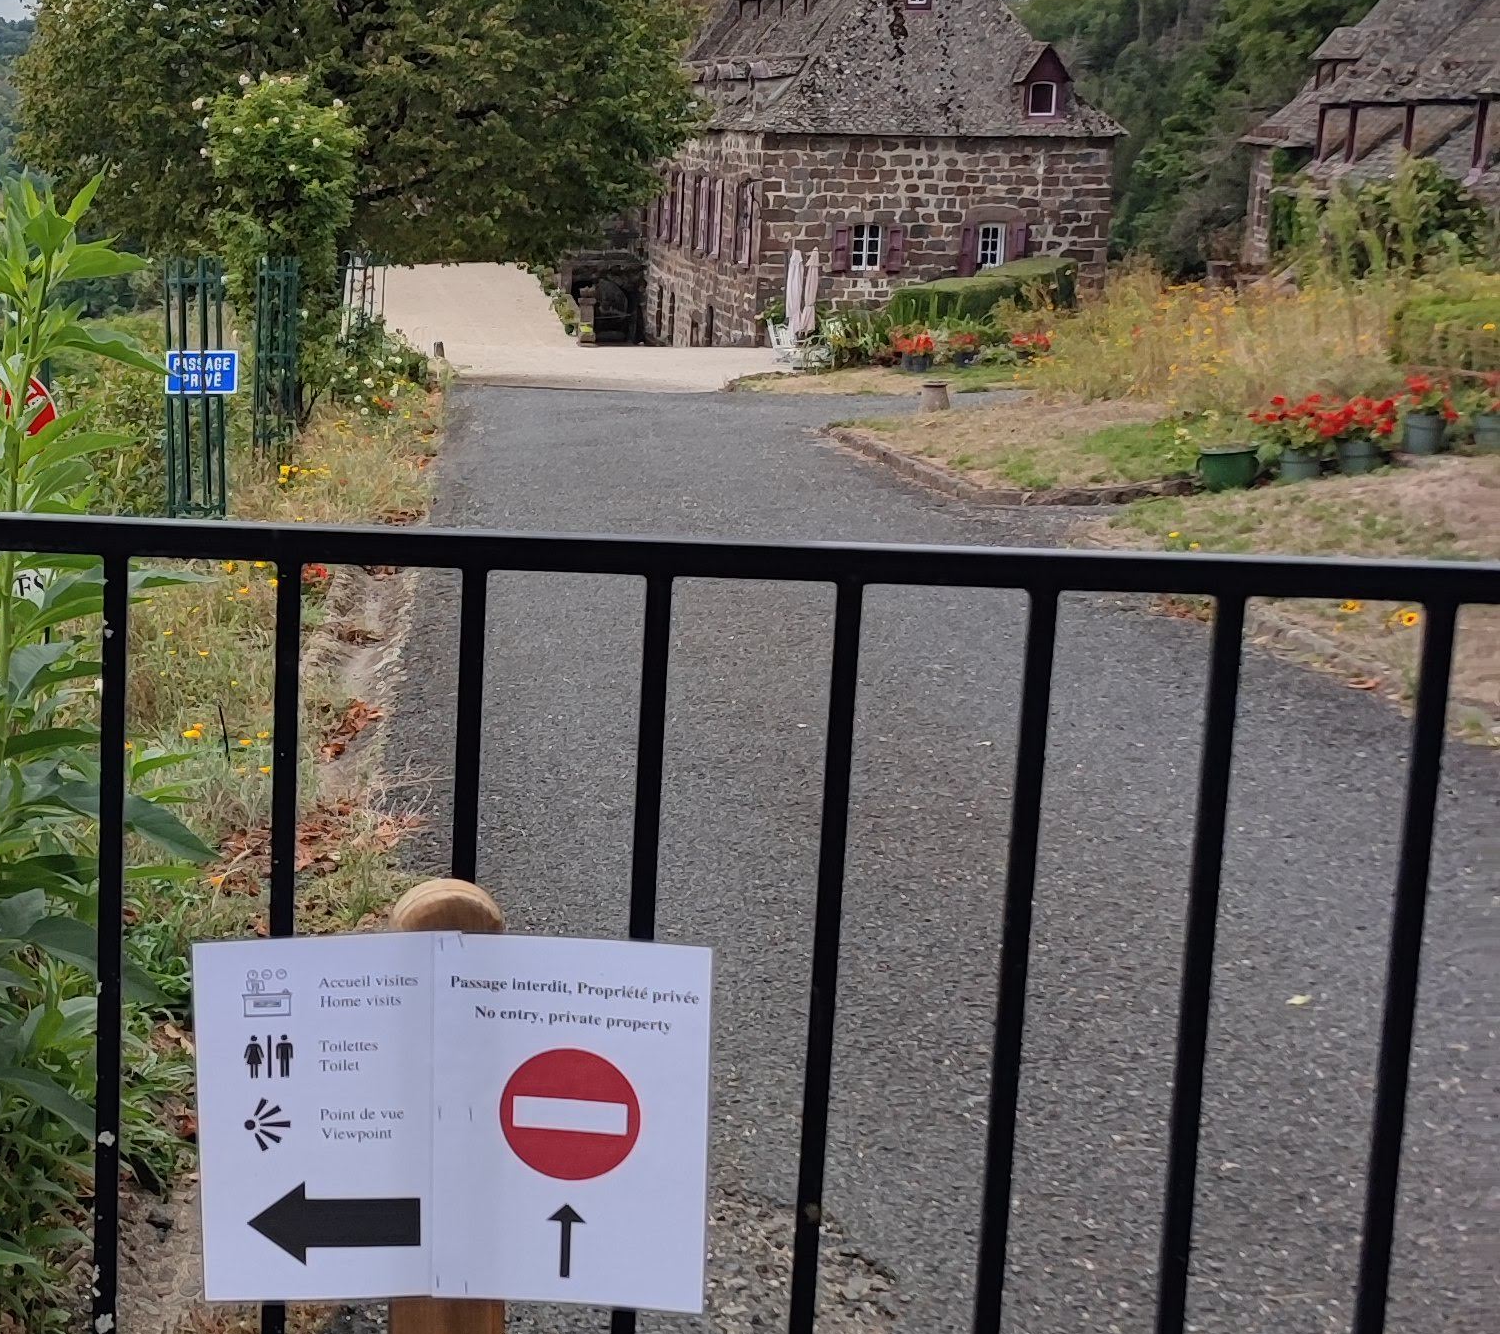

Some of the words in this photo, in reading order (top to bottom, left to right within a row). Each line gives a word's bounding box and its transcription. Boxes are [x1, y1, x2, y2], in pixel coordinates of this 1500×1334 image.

[172, 356, 232, 372] PASSAGE
[318, 975, 370, 988] Accueil
[375, 974, 419, 987] visites
[450, 975, 508, 993] Passage
[577, 981, 648, 1000] Propriété
[652, 990, 700, 1004] privée
[320, 995, 361, 1008] Home
[366, 993, 402, 1006] visits
[474, 1006, 496, 1019] No
[500, 1009, 544, 1024] entry,
[548, 1011, 602, 1026] private
[606, 1017, 672, 1035] property
[318, 1040, 379, 1053] Toilettes
[318, 1059, 360, 1072] Toilet
[320, 1108, 355, 1121] Point
[359, 1108, 376, 1120] de
[380, 1110, 405, 1120] vue
[321, 1127, 393, 1144] Viewpoint
